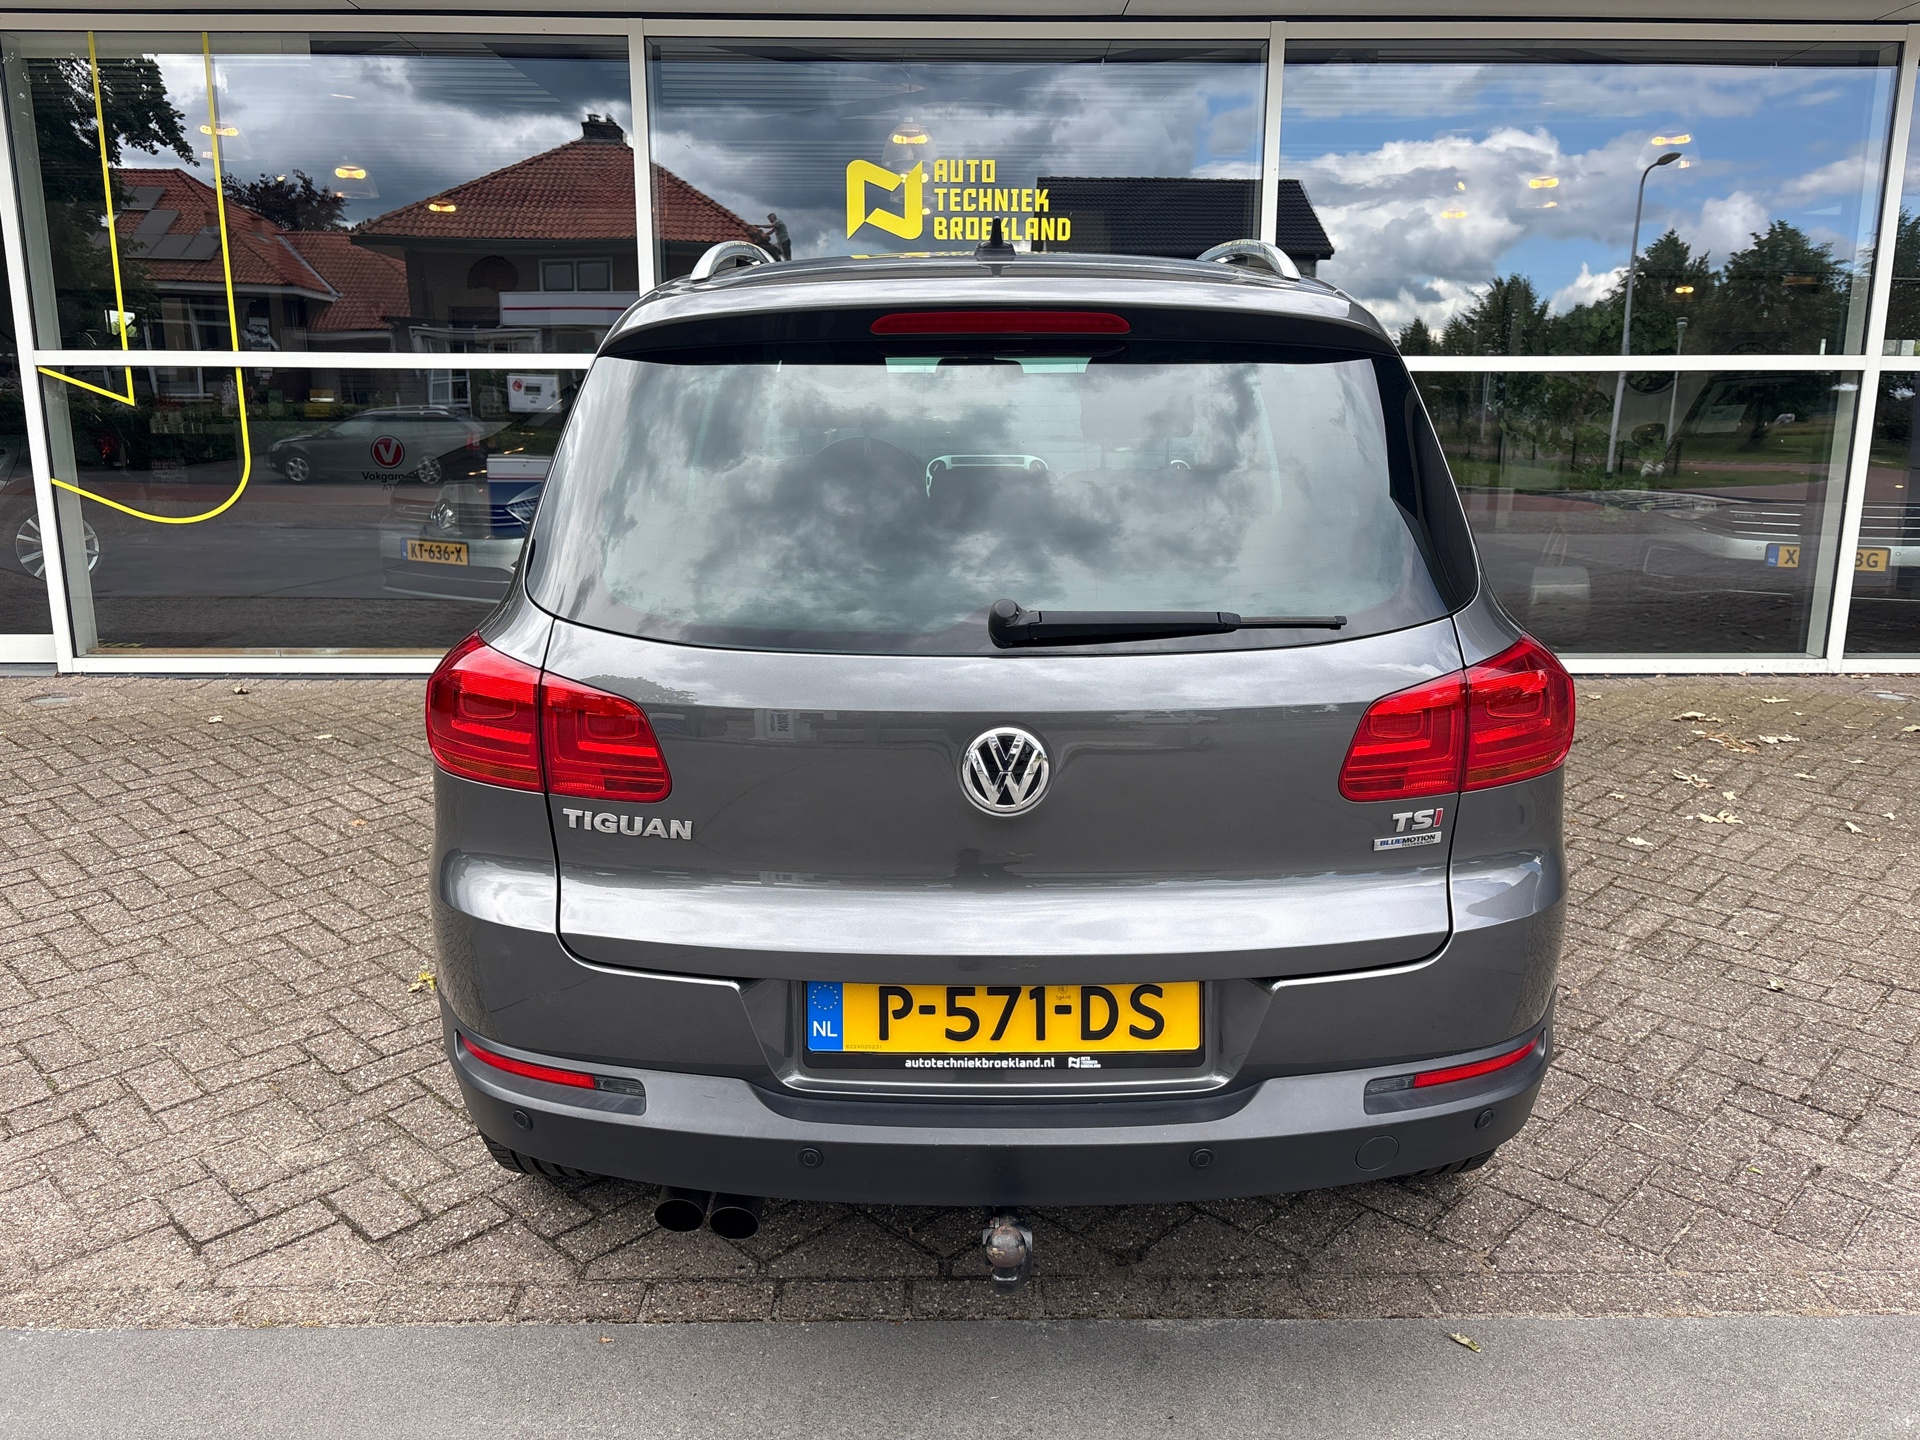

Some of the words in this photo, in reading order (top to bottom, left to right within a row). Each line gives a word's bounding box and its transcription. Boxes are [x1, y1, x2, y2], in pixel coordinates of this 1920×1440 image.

[933, 159, 996, 183] AUTO
[933, 188, 1050, 213] TECHNIEK
[362, 471, 405, 483] Vakgara
[410, 543, 463, 563] KT-636-X
[562, 807, 693, 841] TIGUAN
[1392, 807, 1444, 833] TSI
[1379, 834, 1436, 847] BLUEMOTION
[813, 1020, 838, 1037] NL
[878, 983, 1165, 1042] P-571-DS
[904, 1057, 1056, 1069] autotechniekbroekland.nl
